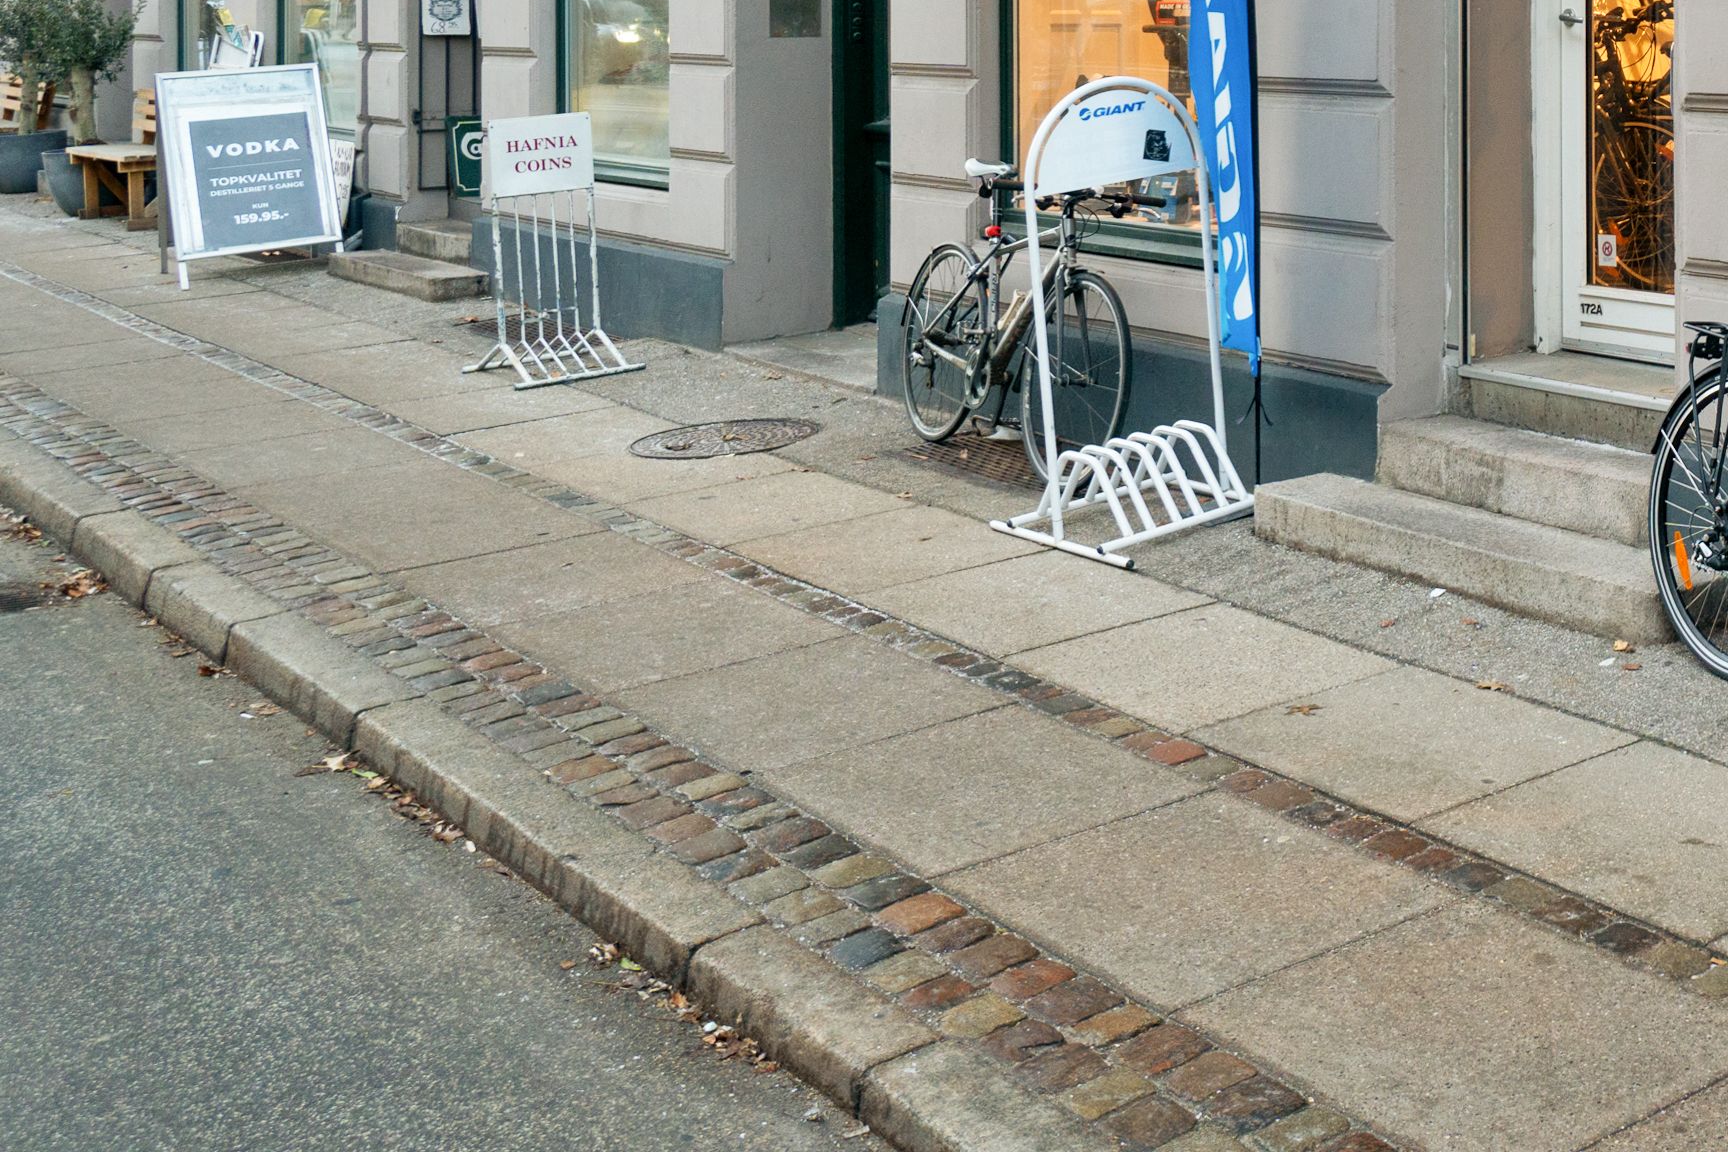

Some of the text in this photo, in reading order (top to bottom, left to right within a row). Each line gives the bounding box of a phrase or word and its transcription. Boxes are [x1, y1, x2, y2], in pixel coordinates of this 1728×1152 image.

[1094, 101, 1146, 118] GIANT
[206, 138, 300, 159] VODKA
[506, 135, 578, 153] HAFNIA
[515, 156, 572, 174] COINS
[210, 169, 302, 188] TOPKVALITET
[210, 184, 267, 198] DESTILLERIET
[275, 180, 305, 191] GANGE
[252, 202, 269, 210] KUN
[1581, 303, 1603, 316] 172A
